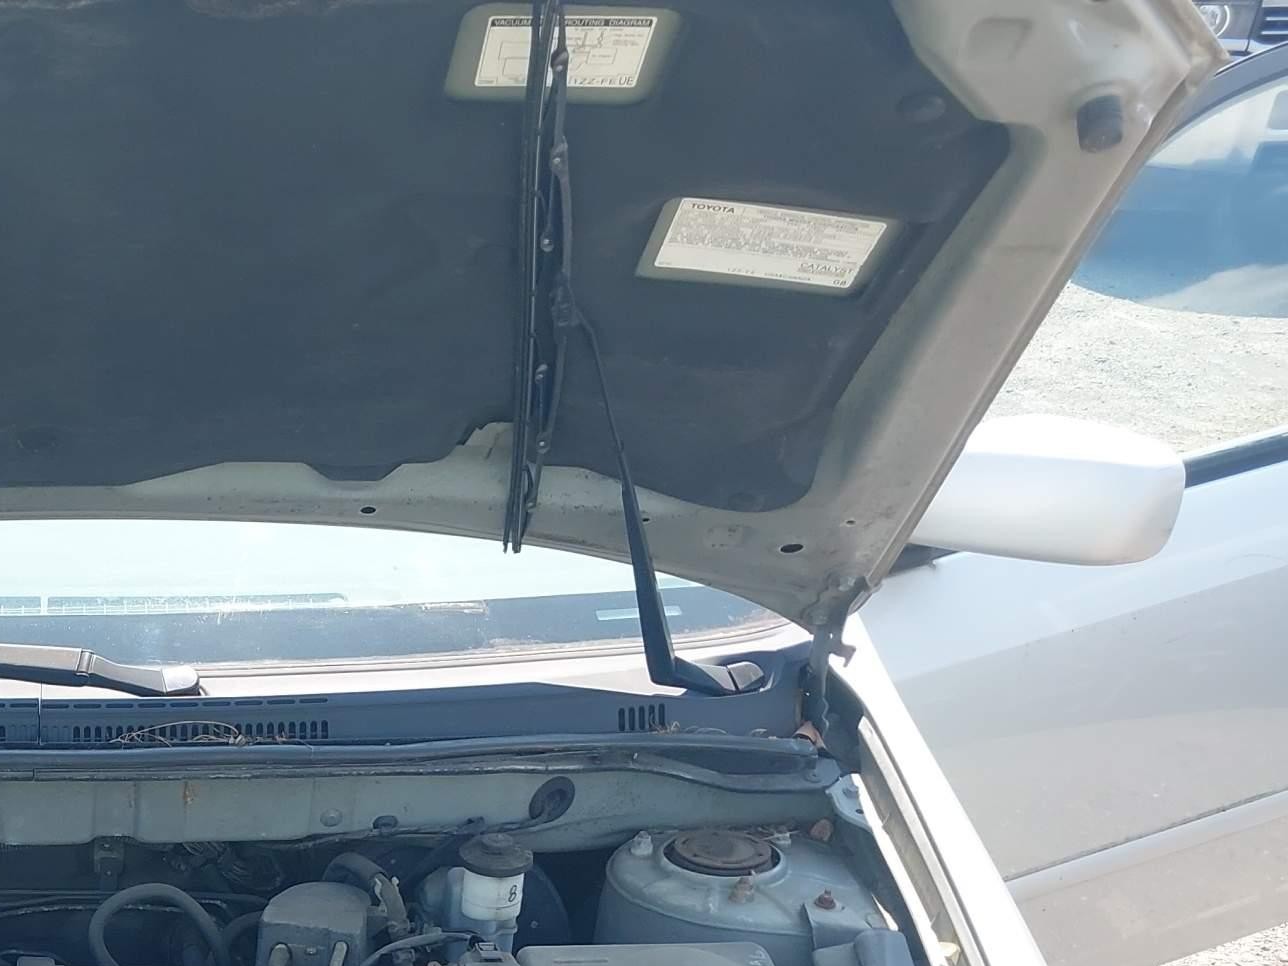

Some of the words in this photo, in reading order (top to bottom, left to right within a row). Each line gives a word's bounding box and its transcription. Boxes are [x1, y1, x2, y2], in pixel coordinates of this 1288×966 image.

[564, 19, 605, 27] ROUTING
[608, 19, 651, 27] DIAGRAM
[691, 203, 735, 214] TOYOTA
[800, 262, 854, 274] CATALYST
